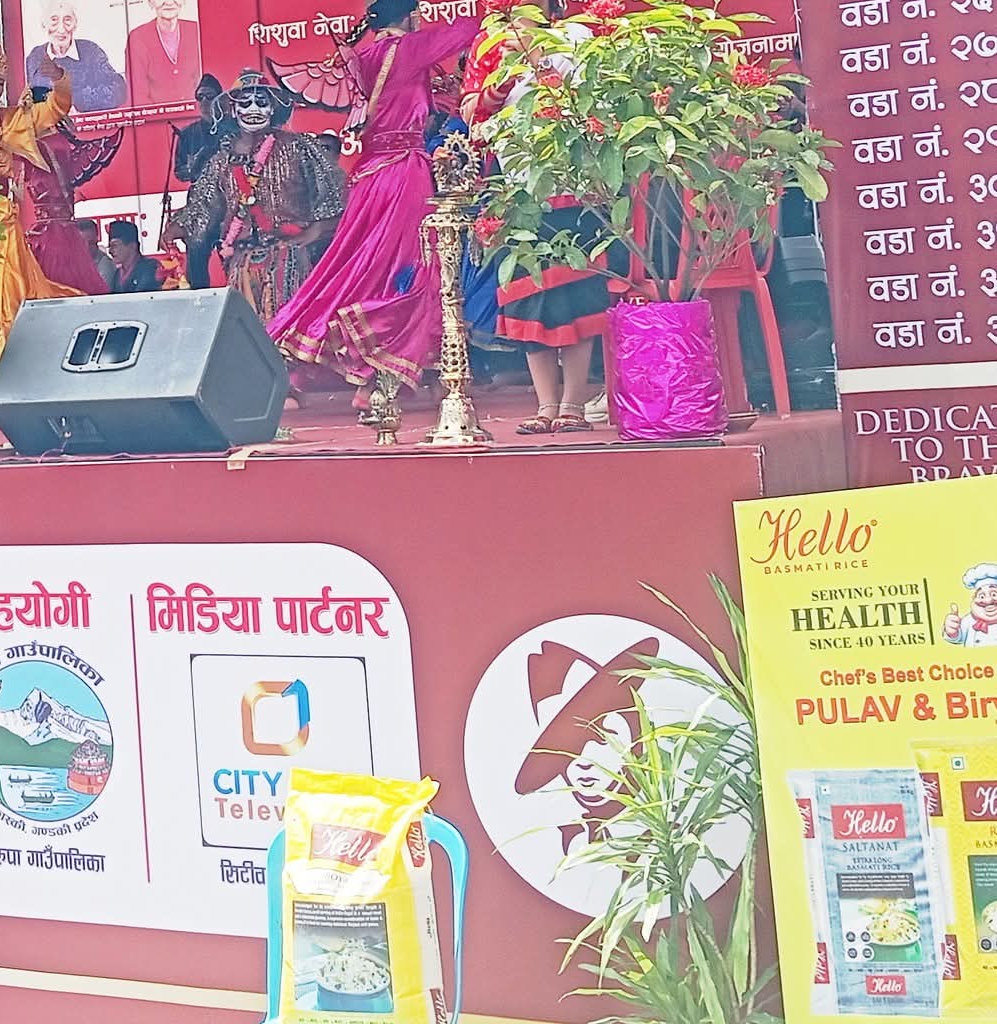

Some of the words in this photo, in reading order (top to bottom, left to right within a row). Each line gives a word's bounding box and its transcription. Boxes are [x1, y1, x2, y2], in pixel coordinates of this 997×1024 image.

[248, 21, 308, 47] शिशुवा
[839, 44, 891, 73] वडा
[900, 32, 936, 65] नं.
[891, 436, 944, 463] TO
[750, 507, 873, 564] Hello
[764, 562, 831, 575] BASMATI
[834, 559, 869, 571] RICE
[811, 587, 874, 602] SERVING
[877, 584, 920, 598] YOUR
[146, 582, 262, 634] मिडिया
[273, 585, 391, 637] पार्टनर
[790, 601, 924, 632] HEALTH
[809, 636, 853, 651] SINCE
[856, 635, 874, 648] 40
[877, 633, 926, 647] YEARS
[819, 667, 877, 686] Chef's
[881, 666, 925, 684] Best
[928, 662, 995, 681] Choice
[795, 695, 902, 725] PULAV
[913, 693, 937, 720] &
[213, 768, 283, 797] CITY
[839, 809, 899, 836] Hello
[842, 842, 899, 853] SALTANAT
